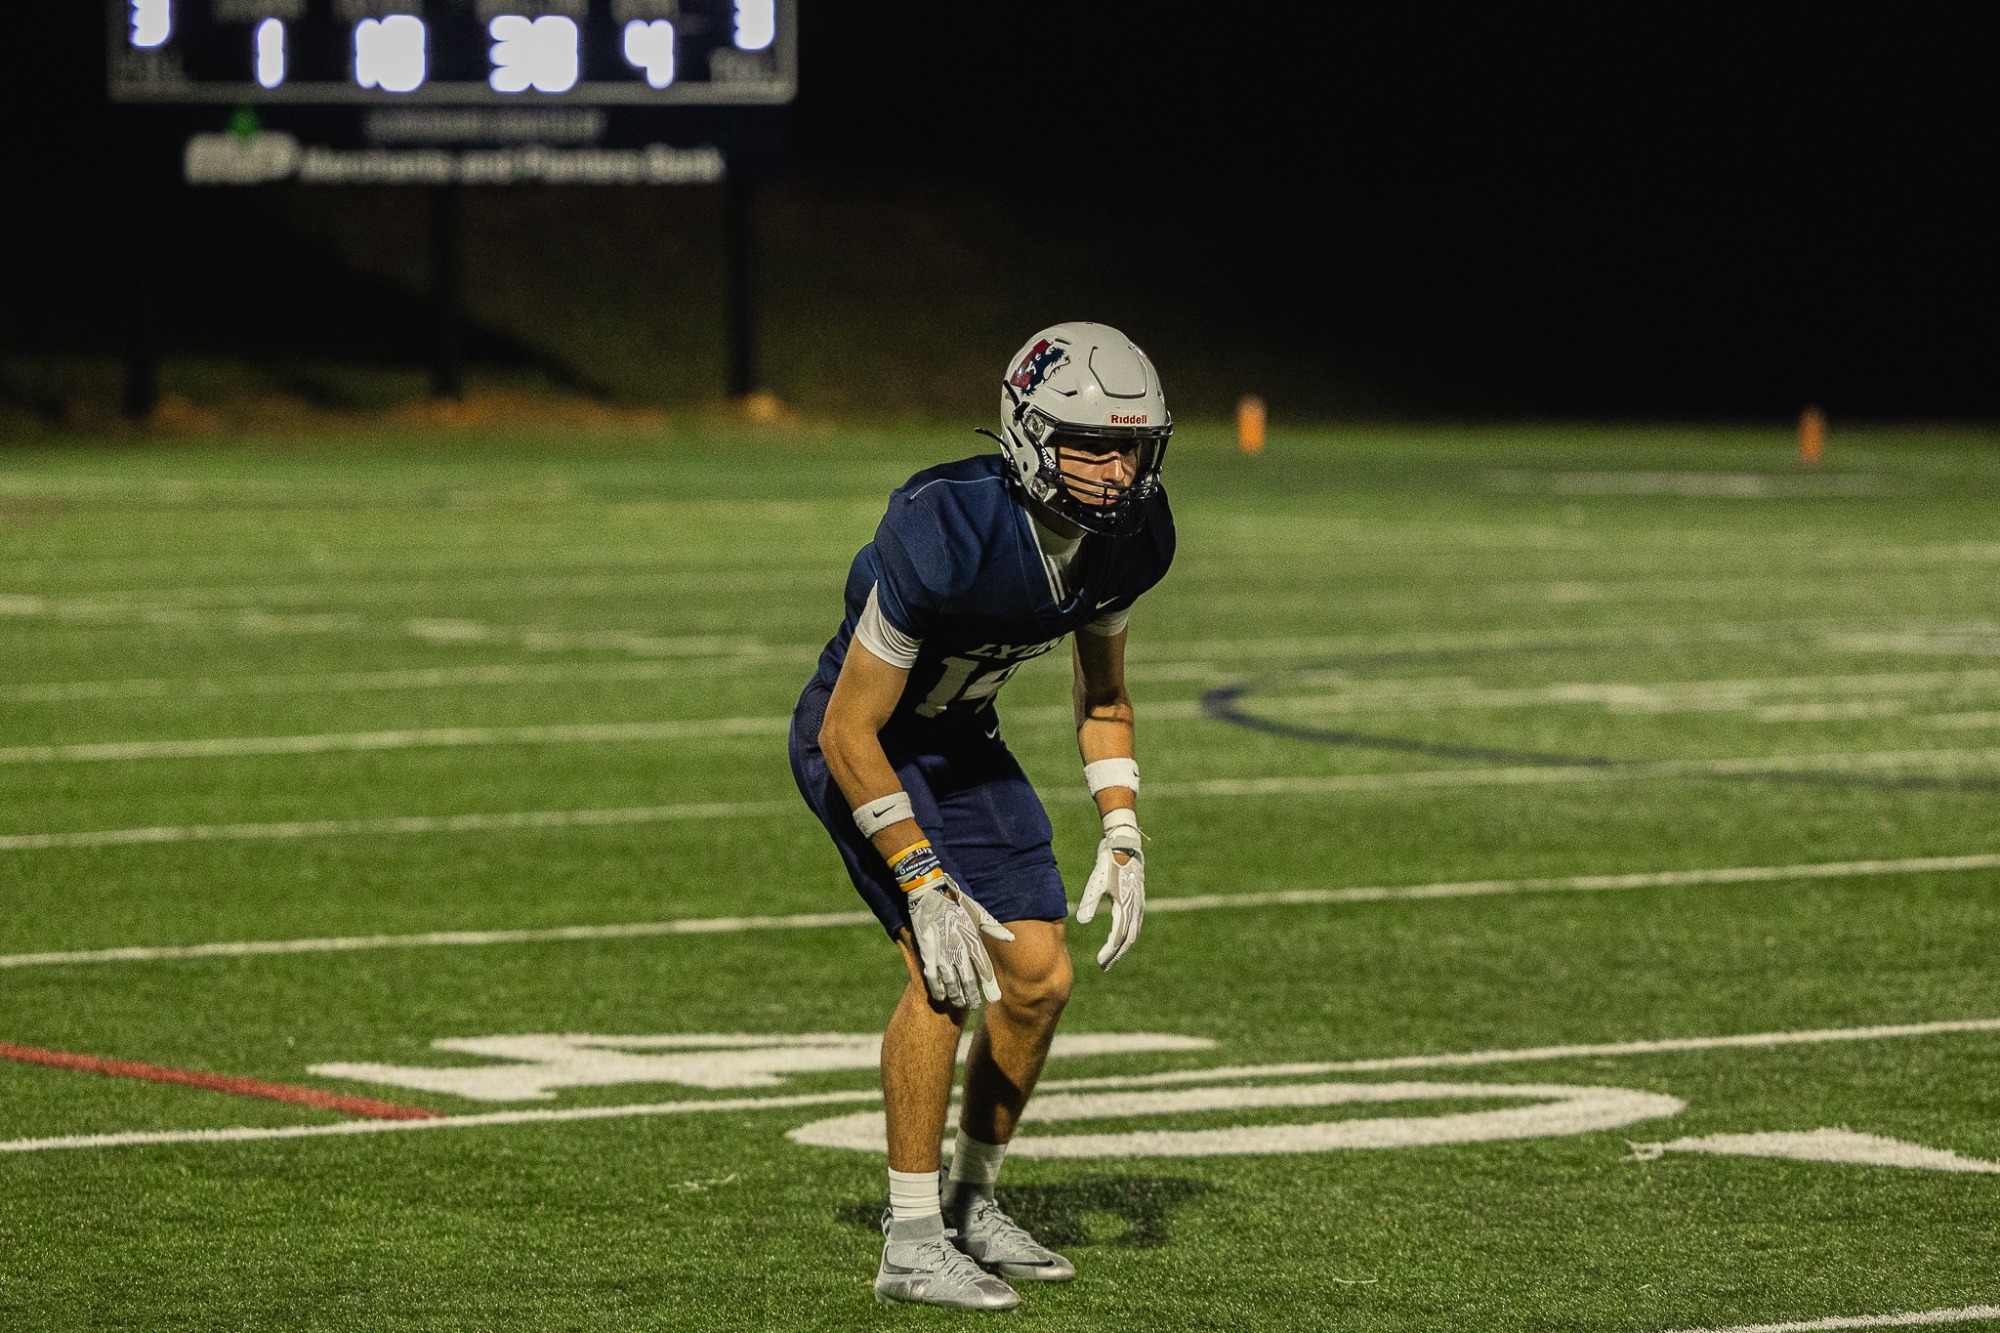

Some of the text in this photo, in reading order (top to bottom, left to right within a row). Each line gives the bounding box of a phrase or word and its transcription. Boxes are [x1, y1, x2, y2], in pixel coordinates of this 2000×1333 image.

[257, 19, 284, 87] 1
[489, 15, 578, 93] 30
[624, 20, 674, 88] 4
[1110, 414, 1147, 425] Riddell
